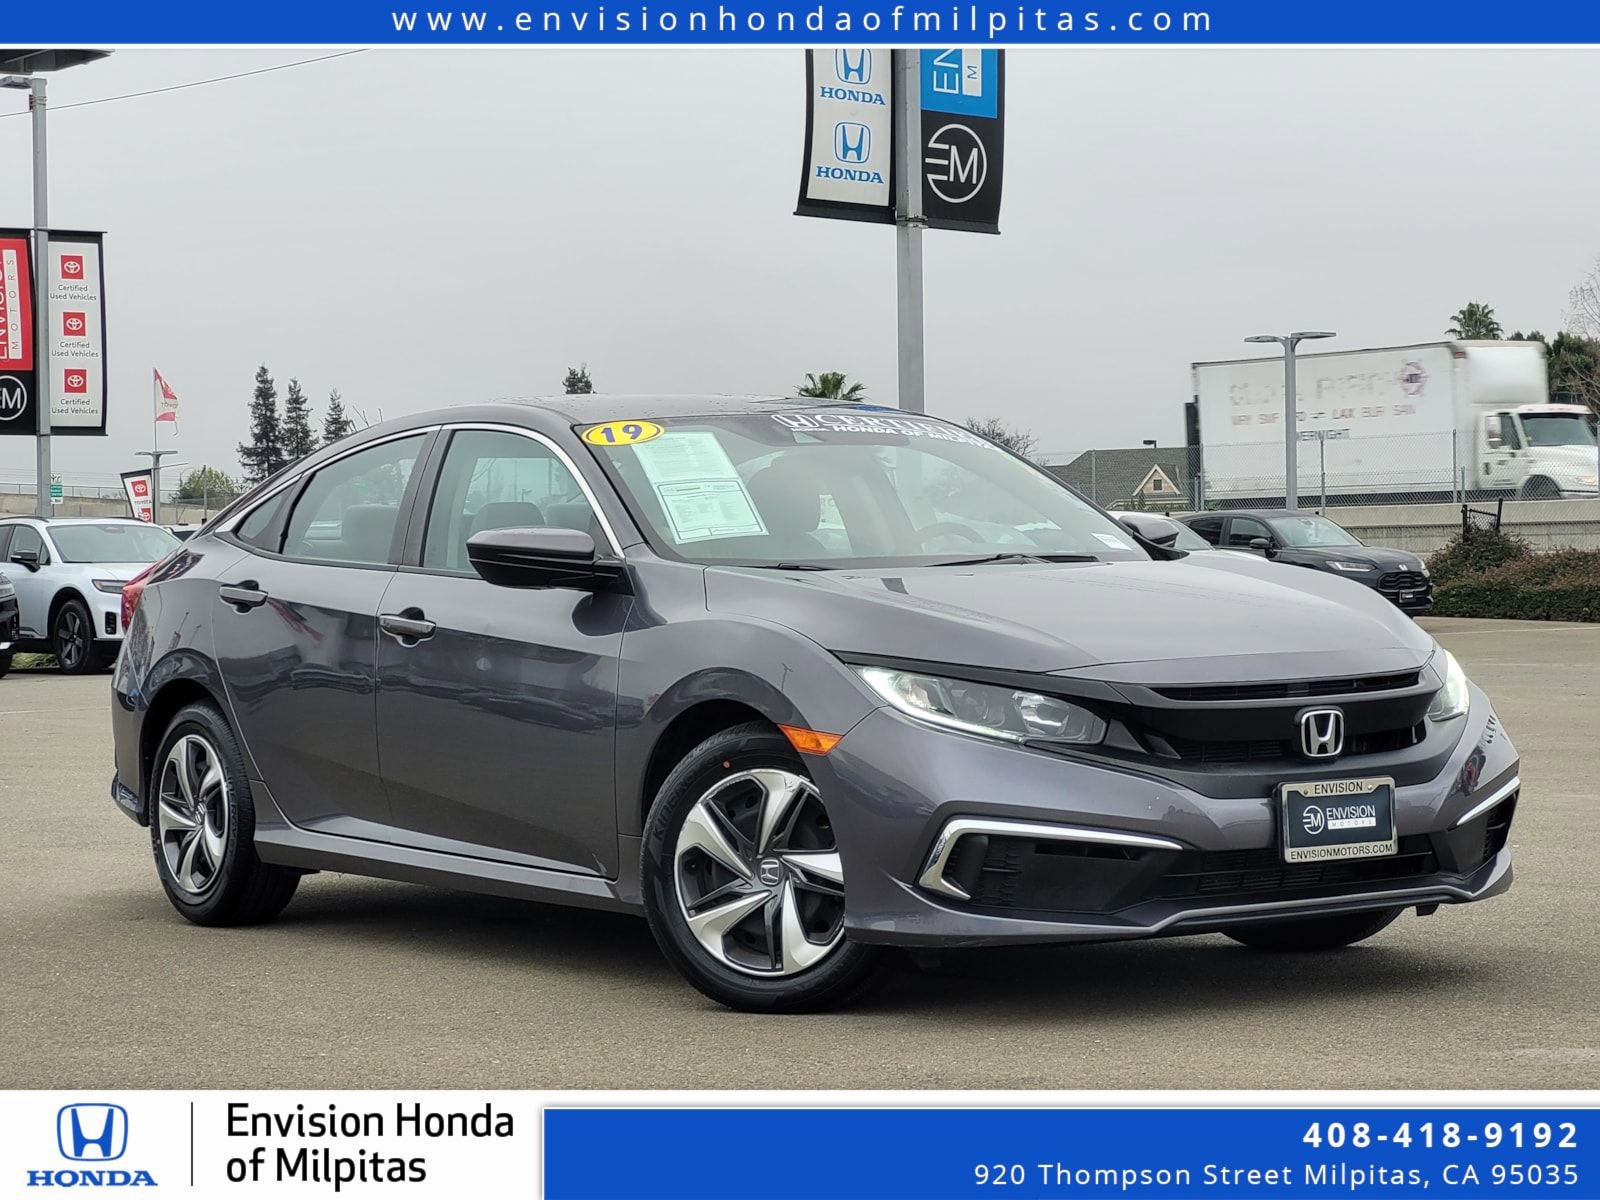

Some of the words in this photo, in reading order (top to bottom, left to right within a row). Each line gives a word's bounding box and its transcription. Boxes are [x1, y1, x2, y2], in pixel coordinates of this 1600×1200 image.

[820, 87, 886, 105] HONDA
[816, 166, 884, 184] HONDA
[7, 258, 19, 350] MOTORS
[69, 293, 97, 301] Vehicles
[600, 424, 643, 443] 19
[833, 425, 898, 435] HONDA
[900, 429, 923, 437] OF
[1314, 781, 1363, 795] ENVISION
[1326, 805, 1376, 820] ENVISION
[1290, 843, 1393, 860] ENVISIONMOTORS.COM
